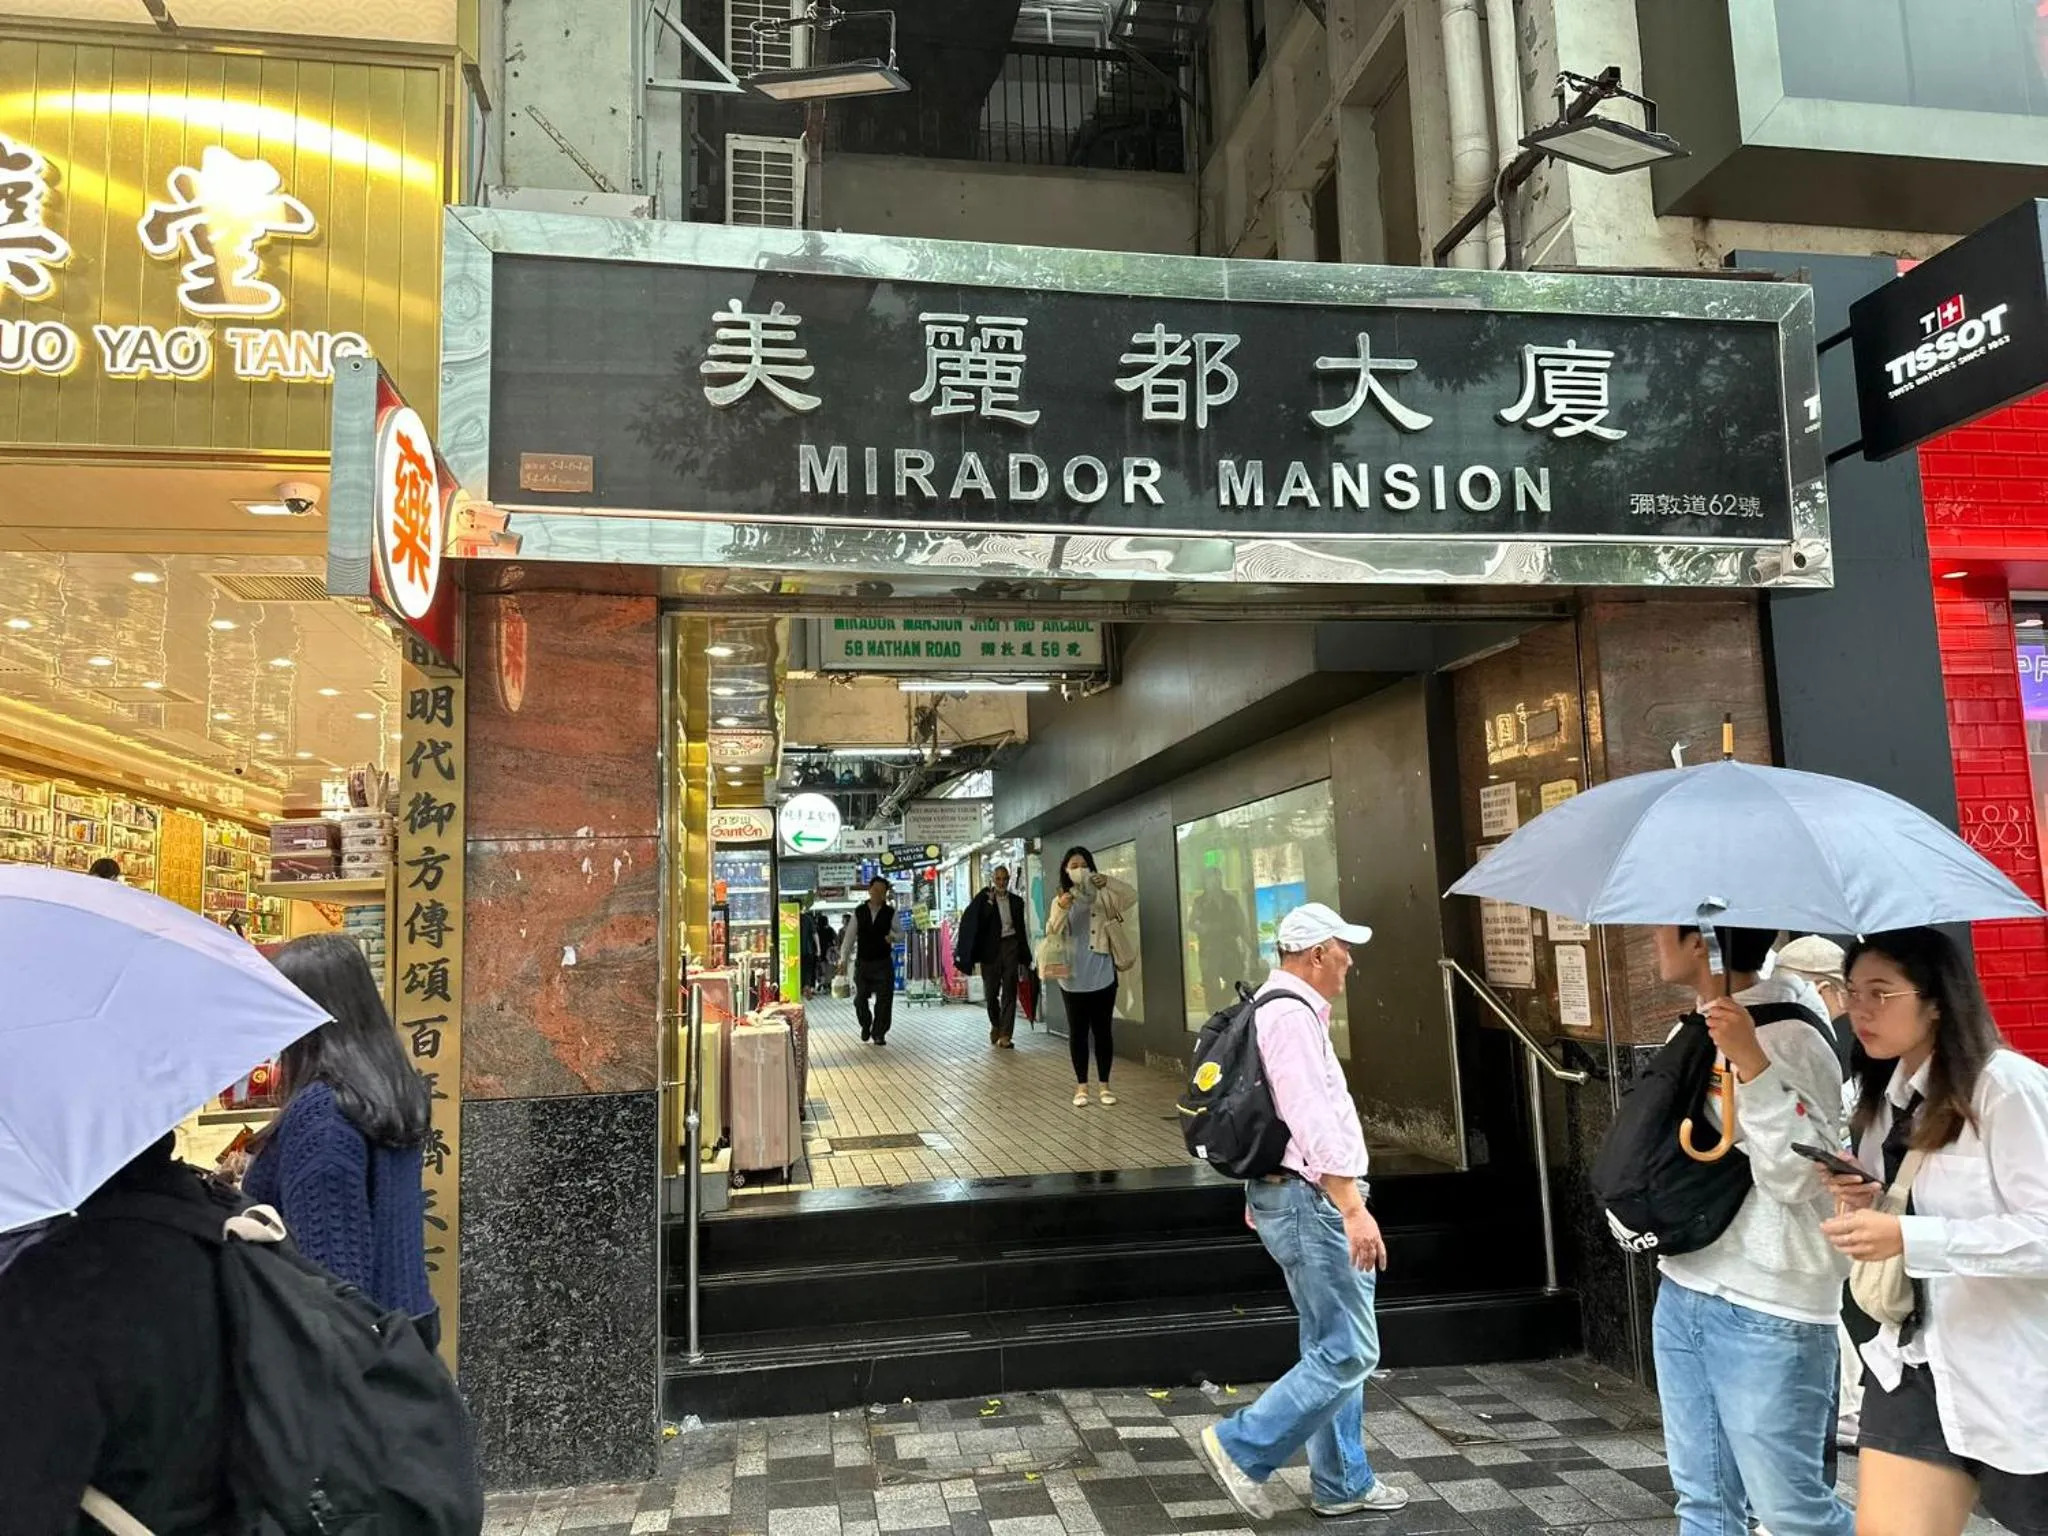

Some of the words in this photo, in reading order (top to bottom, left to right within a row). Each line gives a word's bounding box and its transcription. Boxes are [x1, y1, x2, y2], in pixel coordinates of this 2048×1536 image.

[96, 325, 210, 376] YAO
[700, 298, 1628, 440] 美麗都大廈
[1885, 303, 2008, 385] TISSOT
[1888, 382, 1915, 399] SWISS
[1915, 361, 1957, 386] WATCHES
[1957, 346, 1987, 366] SINCE
[799, 444, 1165, 505] MIRADOR
[1217, 459, 1552, 513] MANSION
[1629, 493, 1764, 518] 彌敦道62號
[867, 641, 921, 657] NATHAN
[925, 641, 961, 657] ROAD
